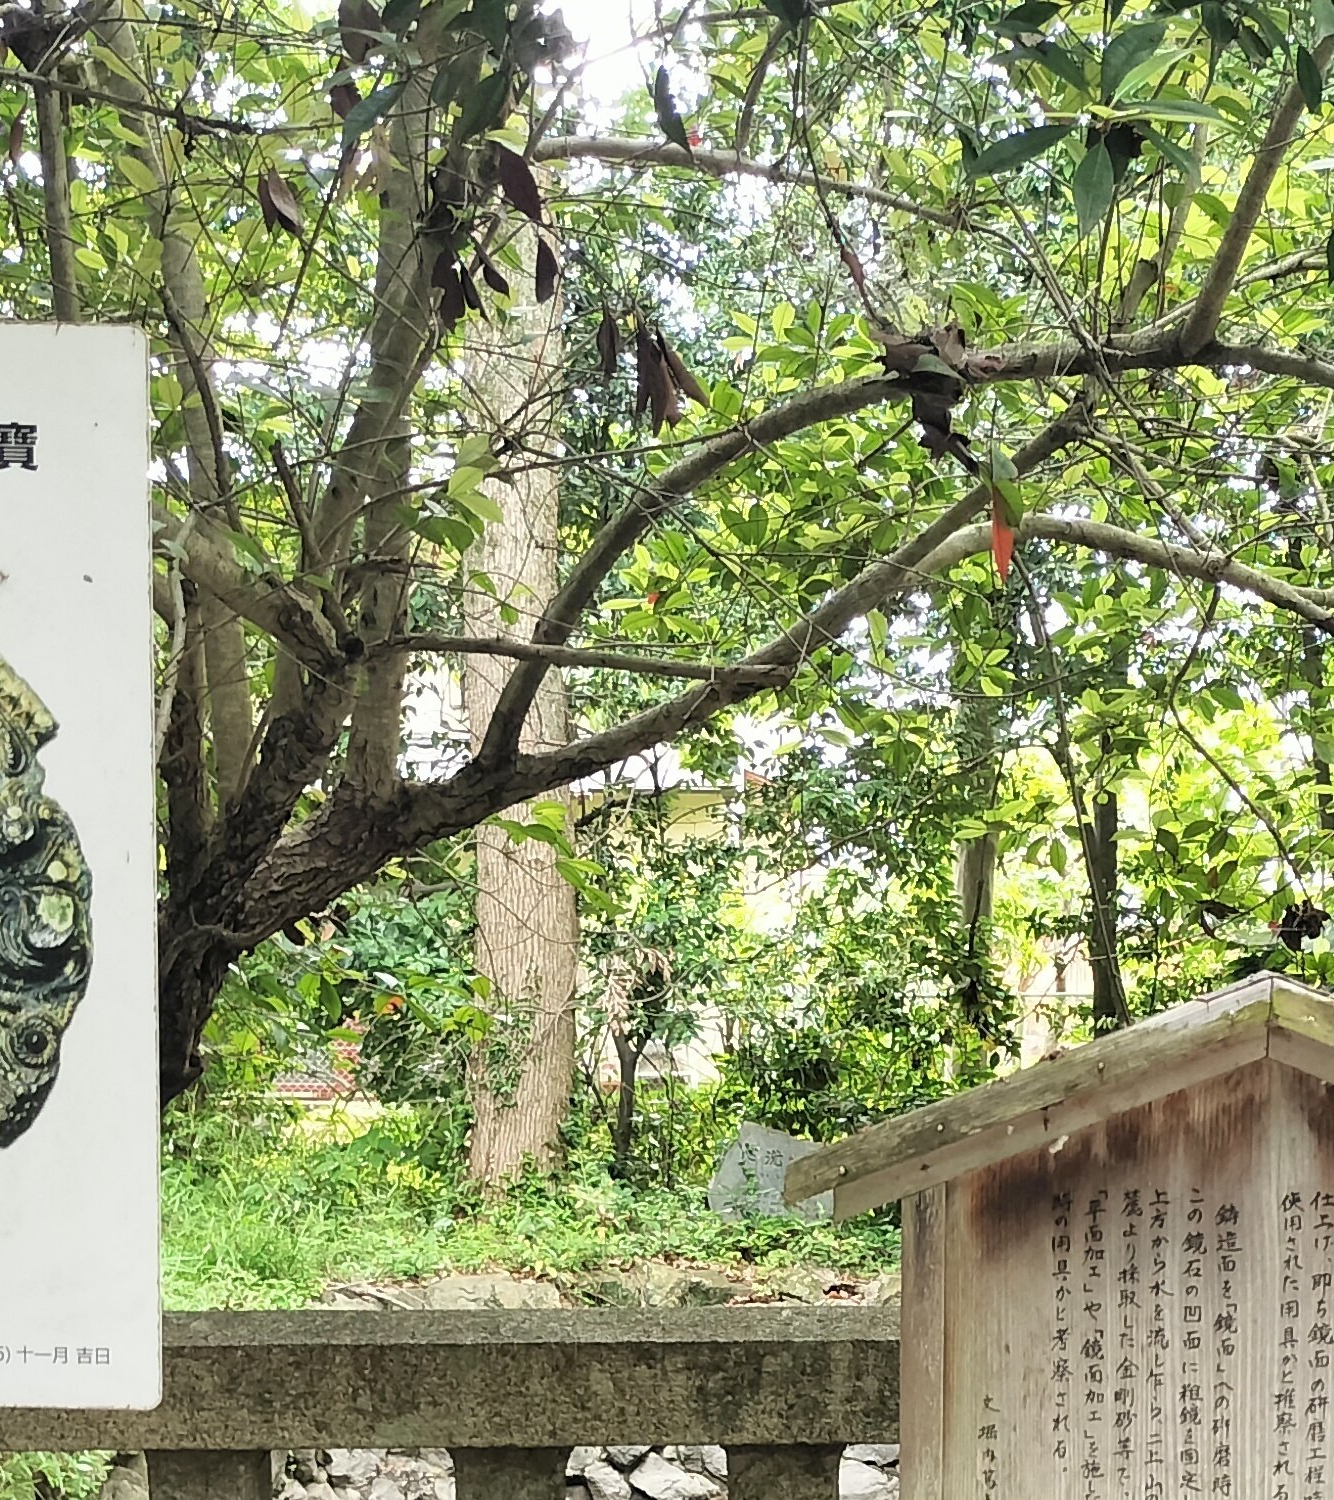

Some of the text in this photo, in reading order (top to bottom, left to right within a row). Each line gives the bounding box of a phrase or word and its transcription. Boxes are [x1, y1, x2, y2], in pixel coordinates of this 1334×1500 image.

[15, 1345, 69, 1365] 十一月
[75, 1346, 112, 1366] 吉日
